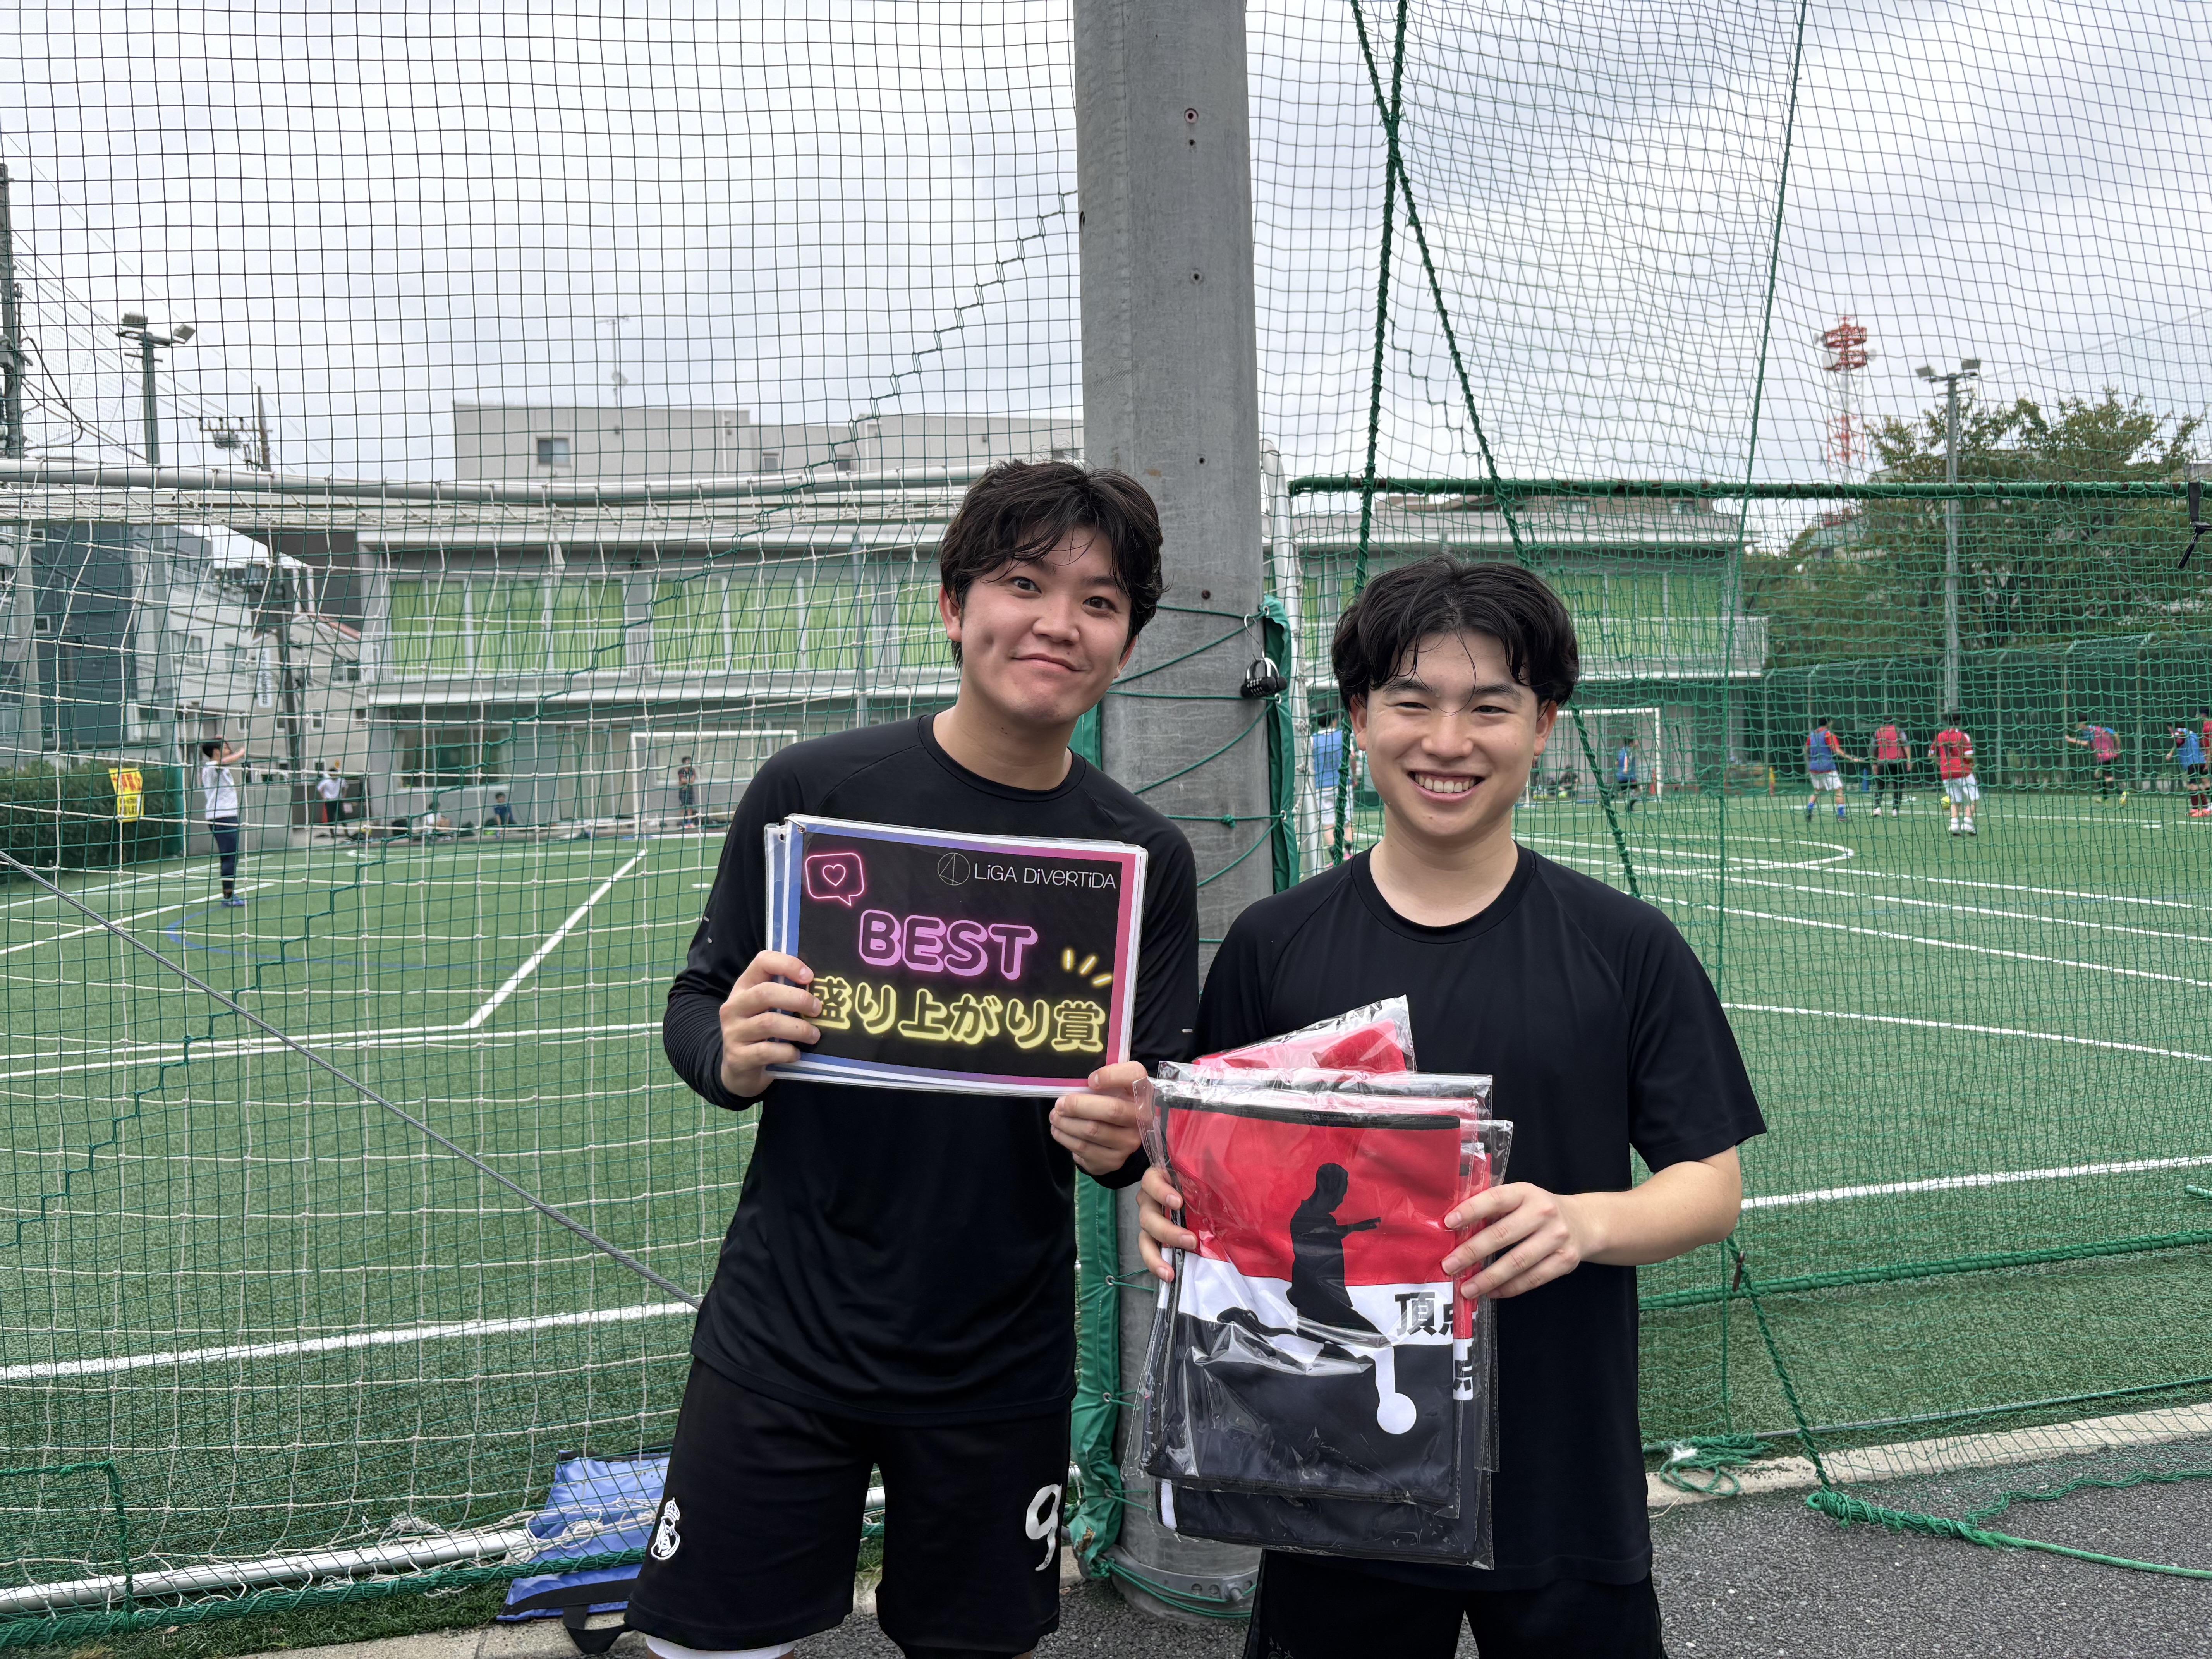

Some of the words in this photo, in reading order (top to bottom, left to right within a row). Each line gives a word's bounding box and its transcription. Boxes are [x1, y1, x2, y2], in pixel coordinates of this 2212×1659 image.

[859, 909, 1038, 980] BEST
[808, 975, 1105, 1052] 盛り上がり賞
[1025, 1484, 1062, 1571] 9
